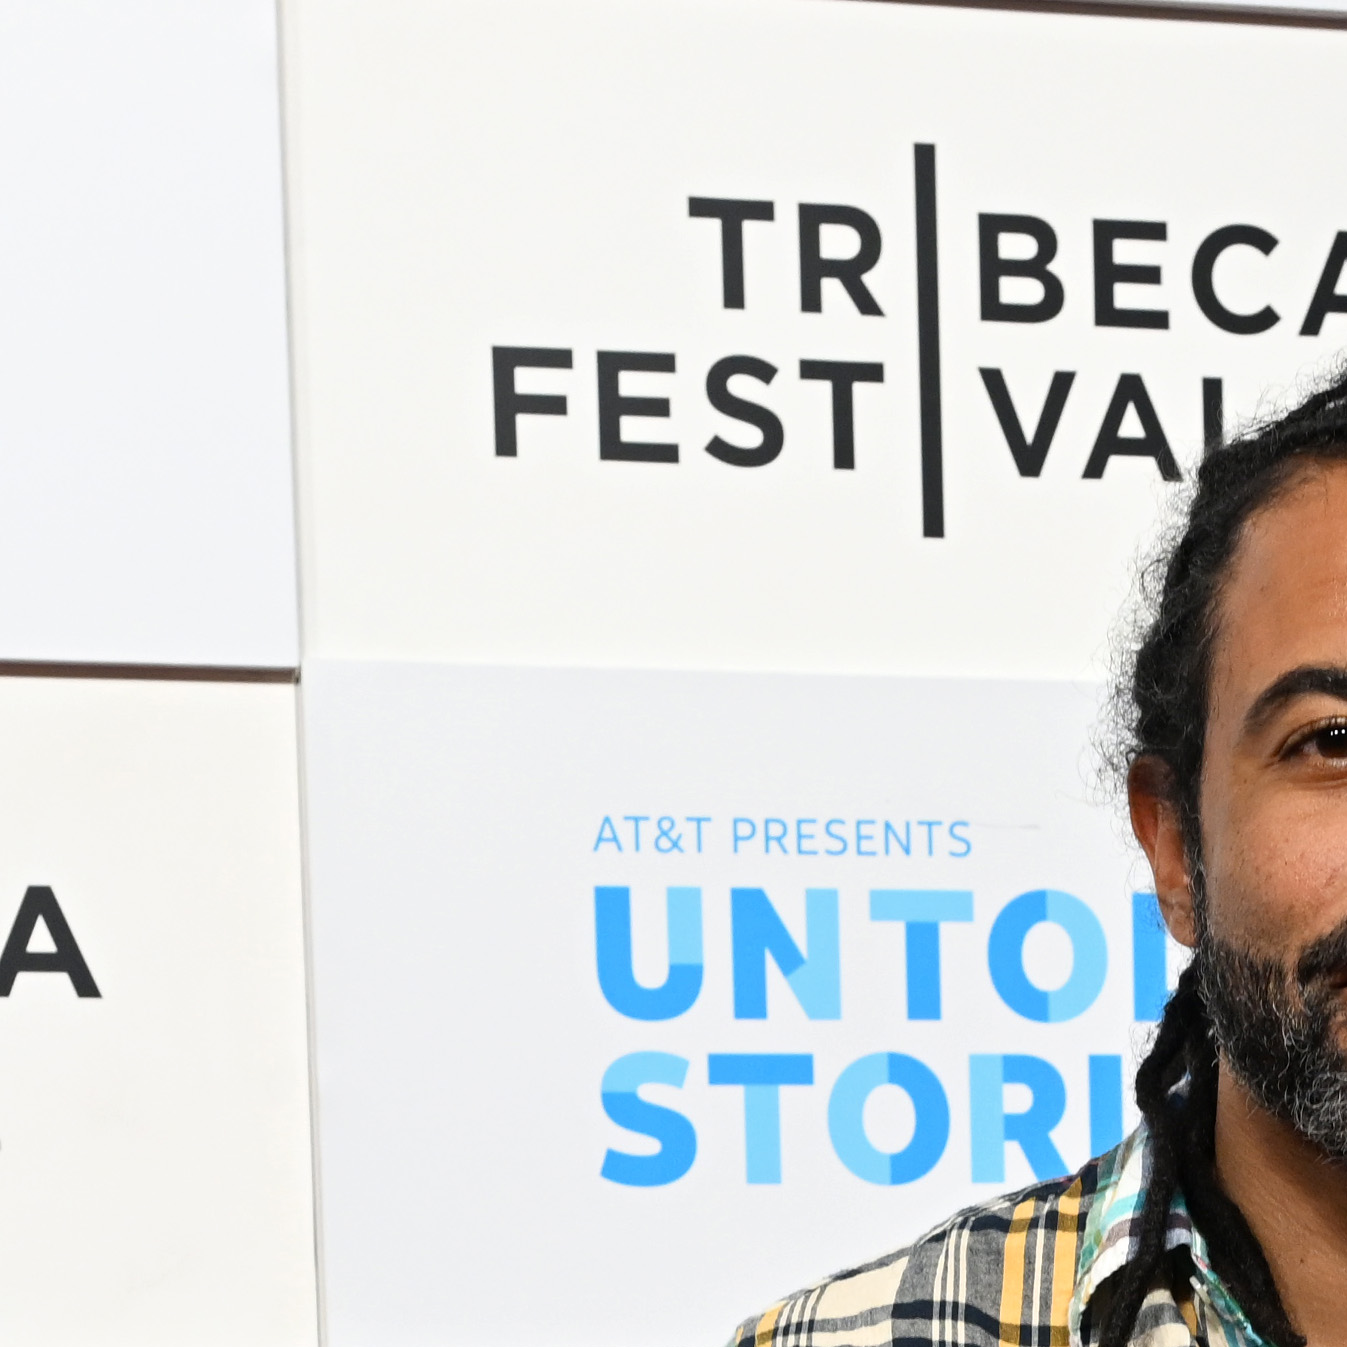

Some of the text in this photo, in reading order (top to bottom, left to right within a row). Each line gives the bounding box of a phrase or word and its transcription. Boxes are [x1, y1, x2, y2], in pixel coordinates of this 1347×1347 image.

[593, 815, 972, 858] AT&T PRESENTS
[593, 885, 1176, 1024] UNTOL
[600, 1051, 1124, 1187] STORI
